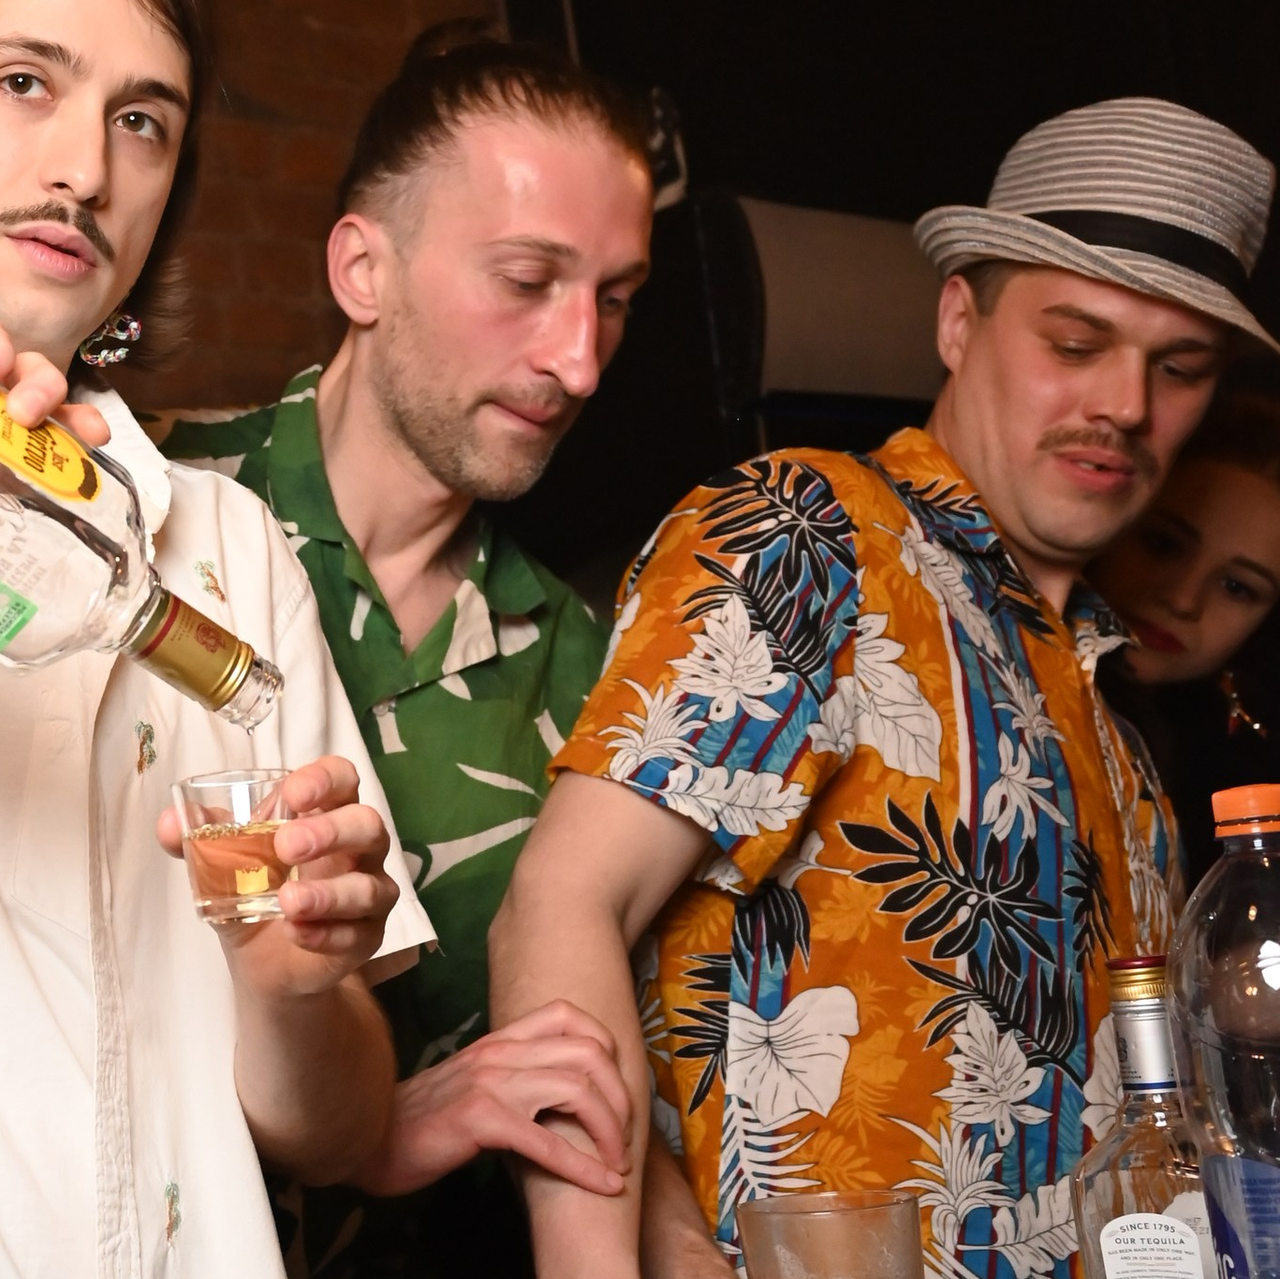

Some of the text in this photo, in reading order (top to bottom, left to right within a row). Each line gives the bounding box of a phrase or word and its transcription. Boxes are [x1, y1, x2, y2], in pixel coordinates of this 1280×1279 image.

[1120, 1222, 1150, 1233] SINCE
[1153, 1223, 1176, 1233] 1795
[1114, 1237, 1186, 1246] OUR TEQUILA
